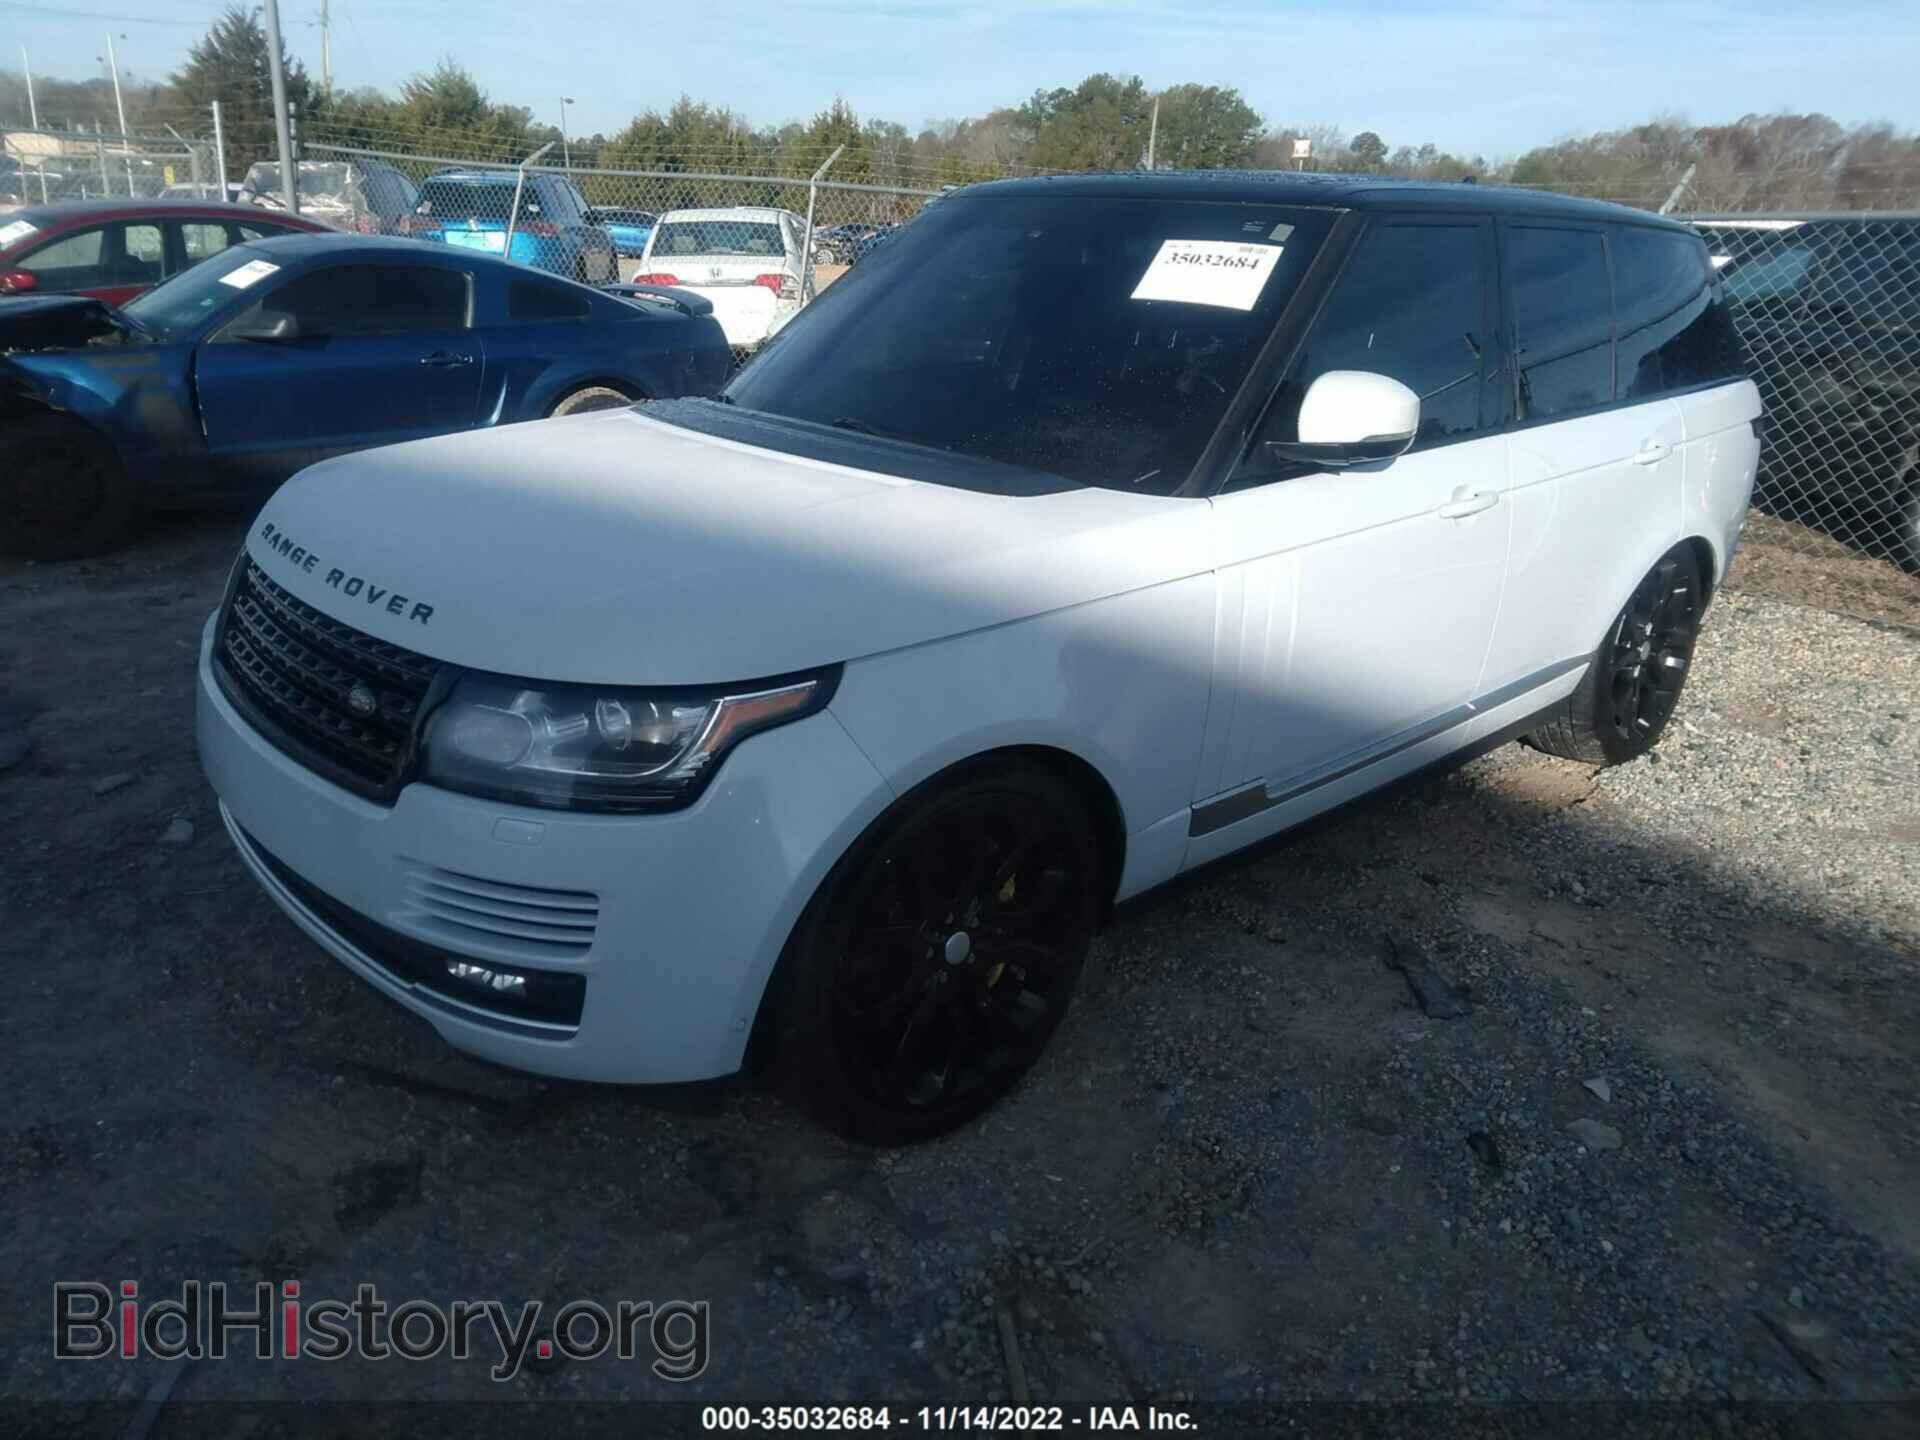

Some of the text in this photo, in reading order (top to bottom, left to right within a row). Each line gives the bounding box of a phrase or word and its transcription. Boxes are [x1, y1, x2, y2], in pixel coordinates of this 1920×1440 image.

[1165, 252, 1261, 271] 35032684
[261, 522, 436, 626] RANGE ROVER
